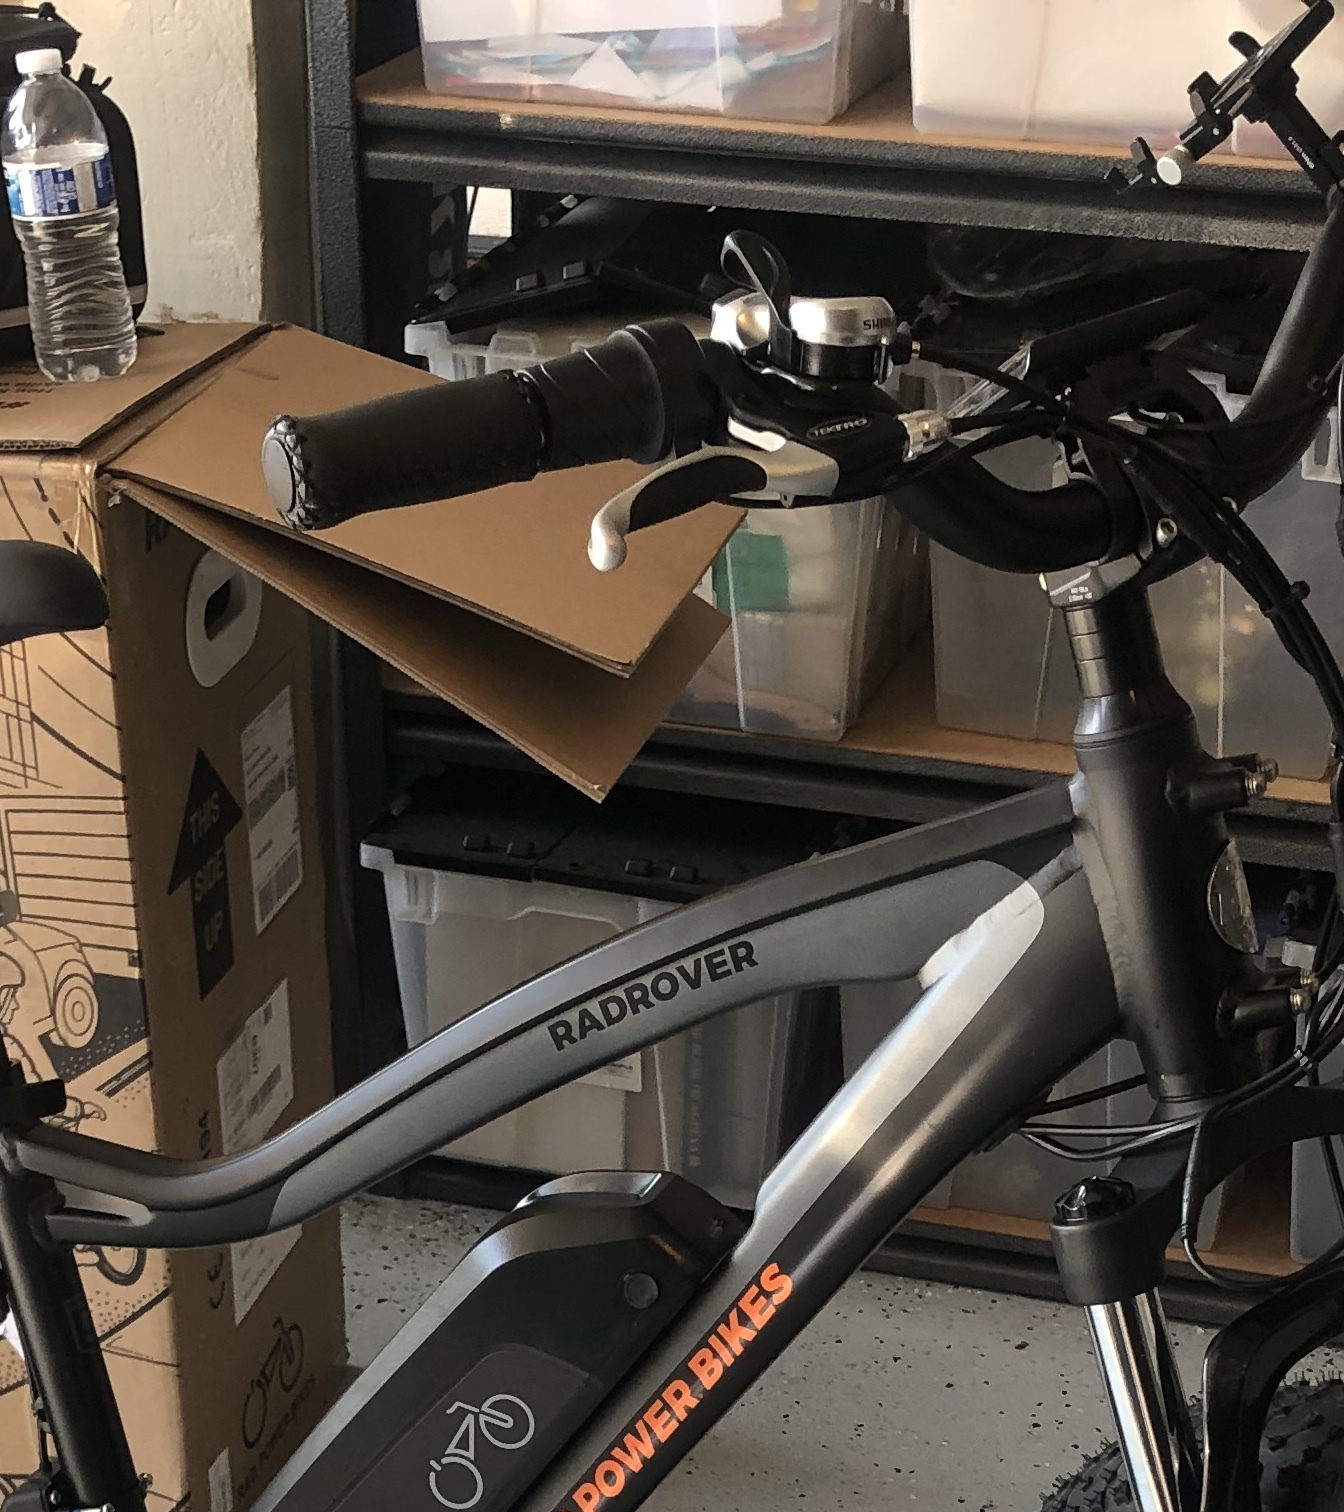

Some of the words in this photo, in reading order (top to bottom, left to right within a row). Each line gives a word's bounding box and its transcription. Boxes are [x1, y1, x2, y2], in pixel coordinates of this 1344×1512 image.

[813, 417, 868, 437] TEKTRO
[547, 940, 759, 1051] RADROVER
[687, 1262, 794, 1391] BIKES
